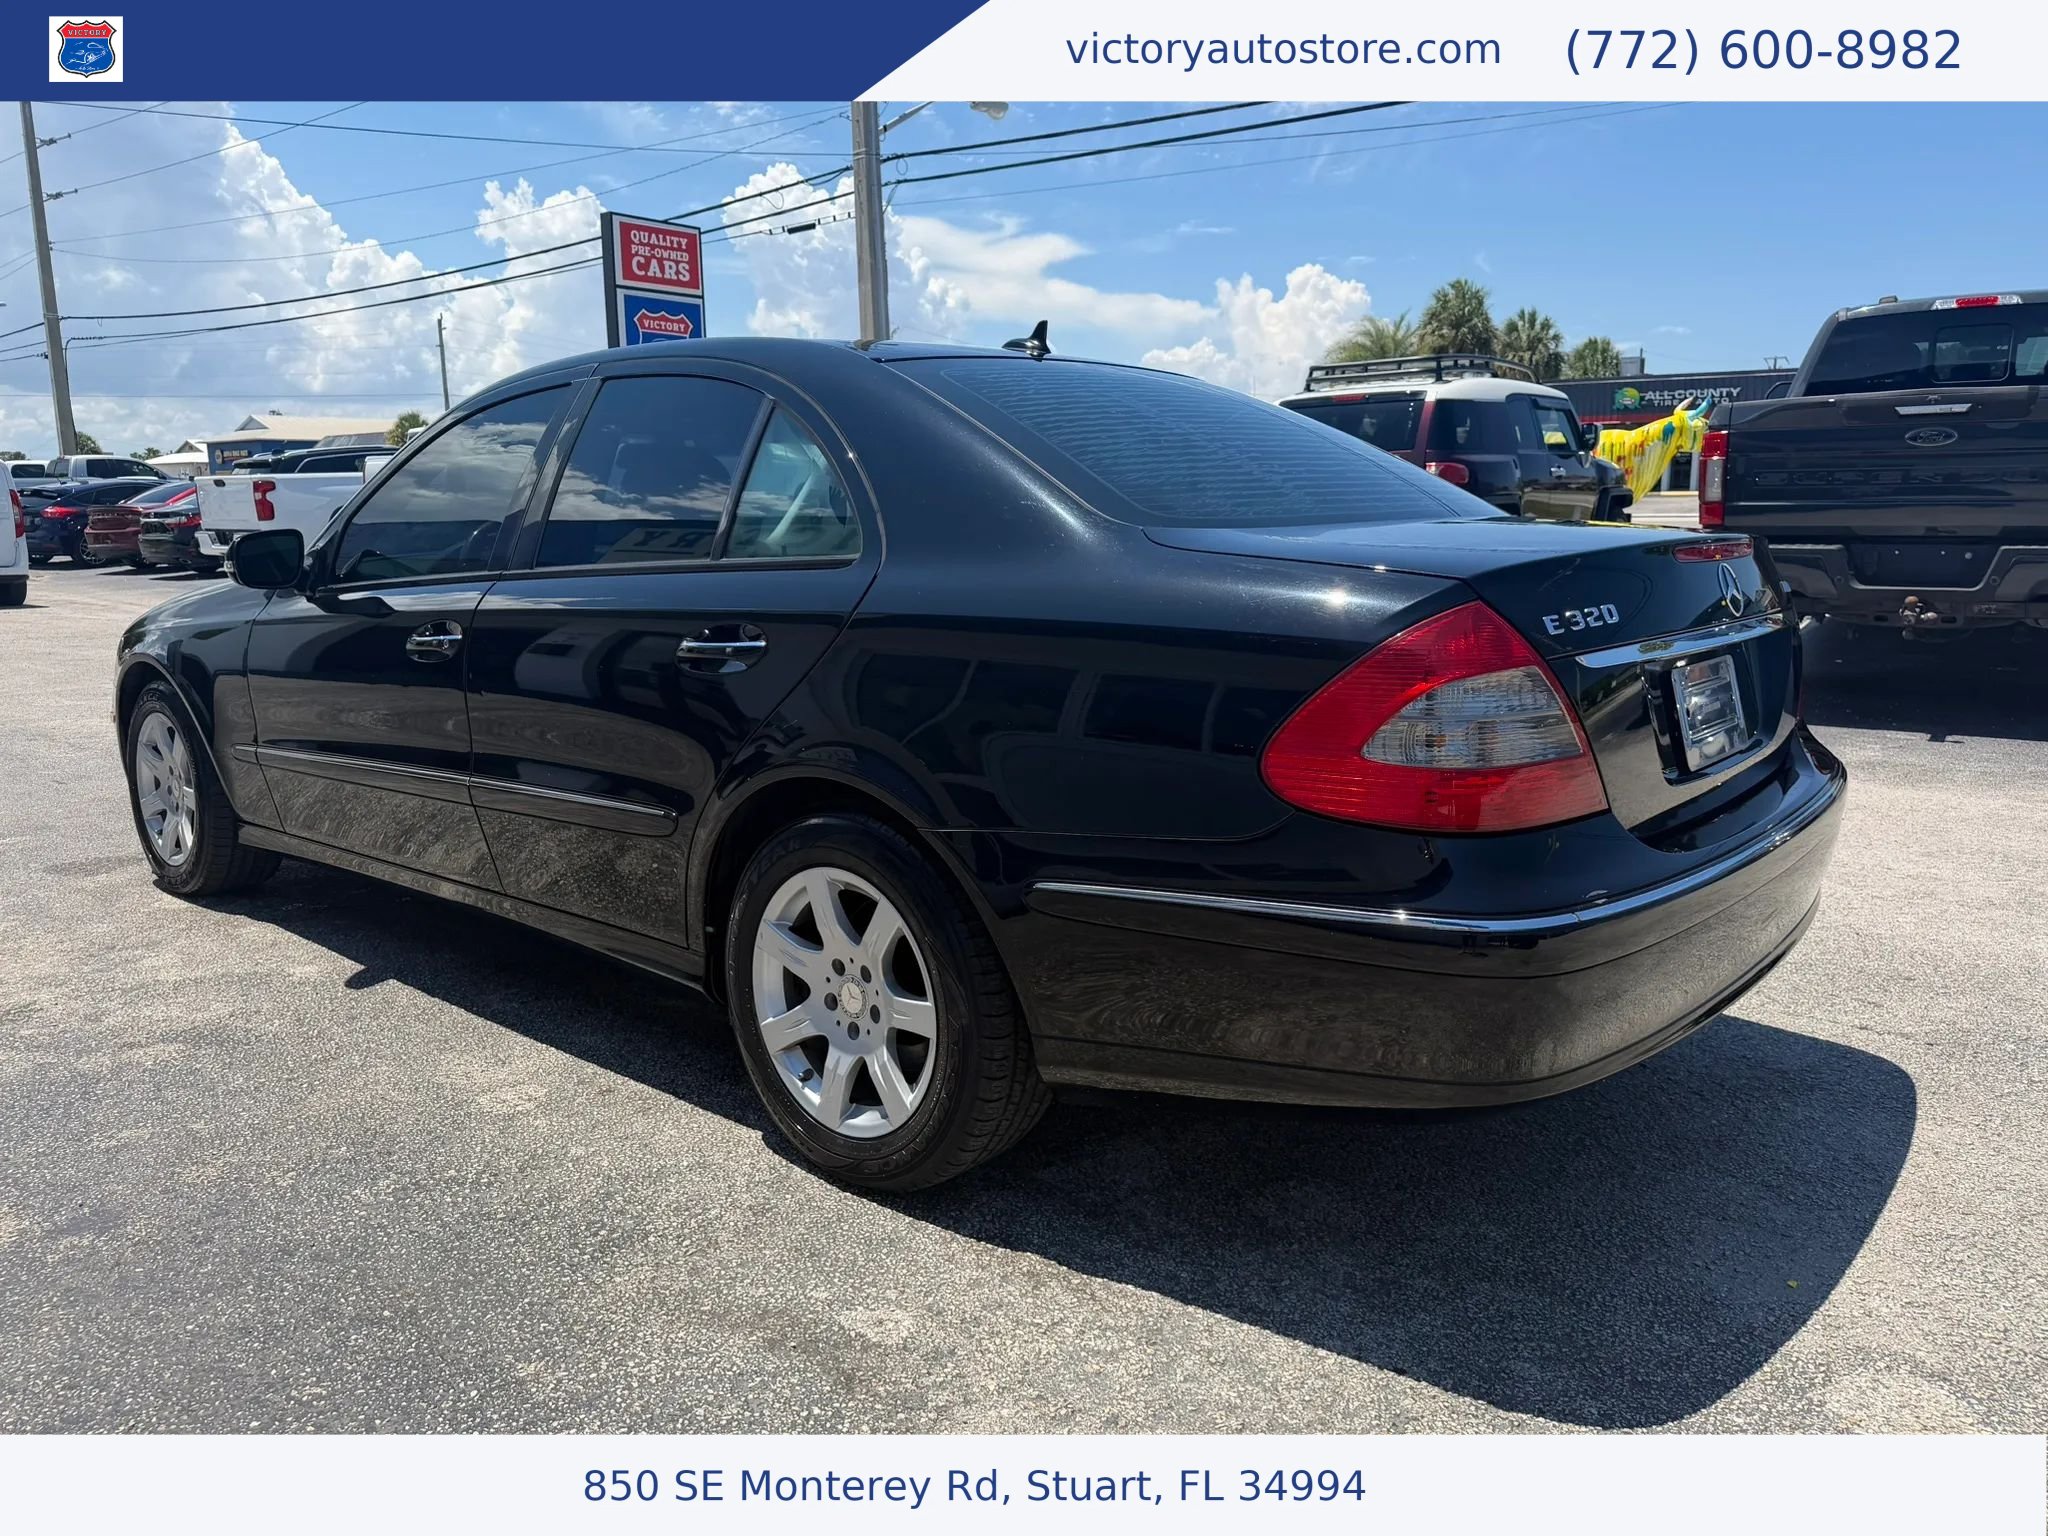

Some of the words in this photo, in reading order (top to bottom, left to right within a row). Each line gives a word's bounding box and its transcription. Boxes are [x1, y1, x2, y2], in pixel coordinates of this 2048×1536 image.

[630, 230, 688, 249] QUALITY
[631, 245, 689, 262] PRE-OWNED
[631, 256, 690, 281] CARS
[642, 318, 685, 332] VICTORY
[1674, 387, 1741, 400] COUNTY
